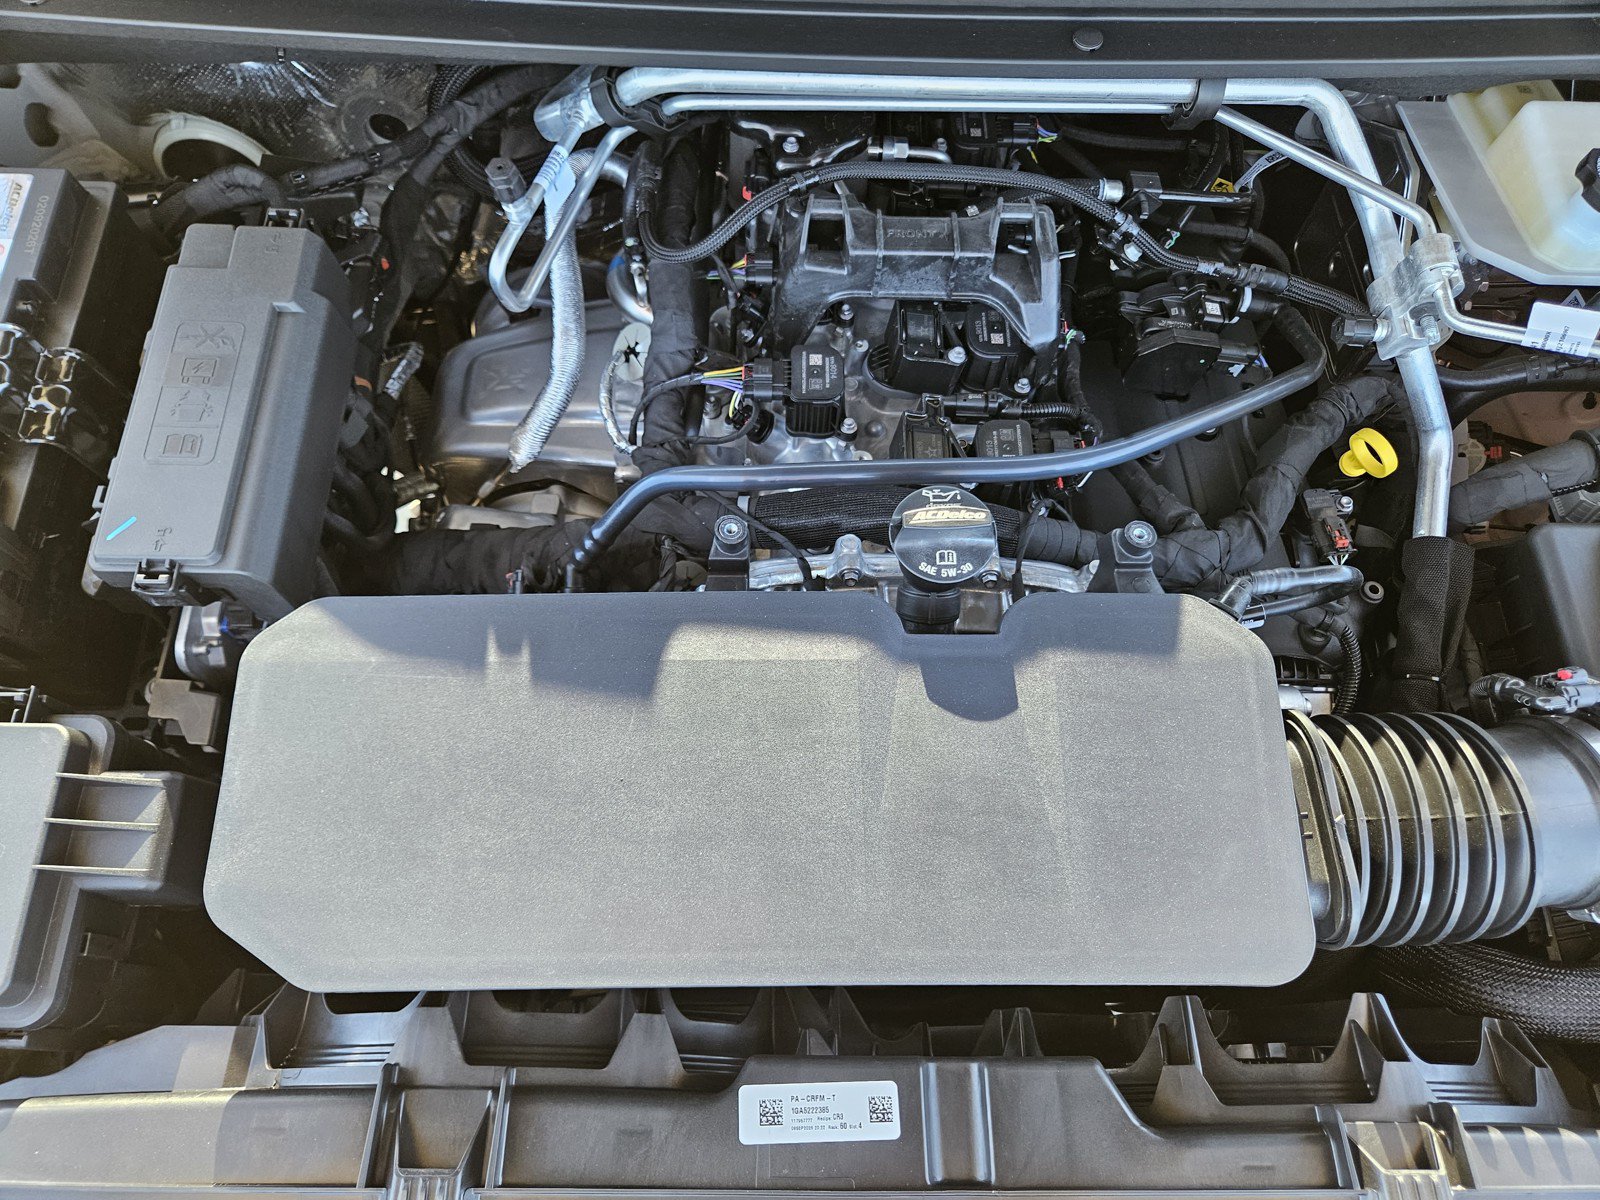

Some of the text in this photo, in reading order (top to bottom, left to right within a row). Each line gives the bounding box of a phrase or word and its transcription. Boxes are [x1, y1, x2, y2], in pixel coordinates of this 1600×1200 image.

[912, 510, 986, 520] ACDelco
[918, 561, 973, 578] SAE 5W-30
